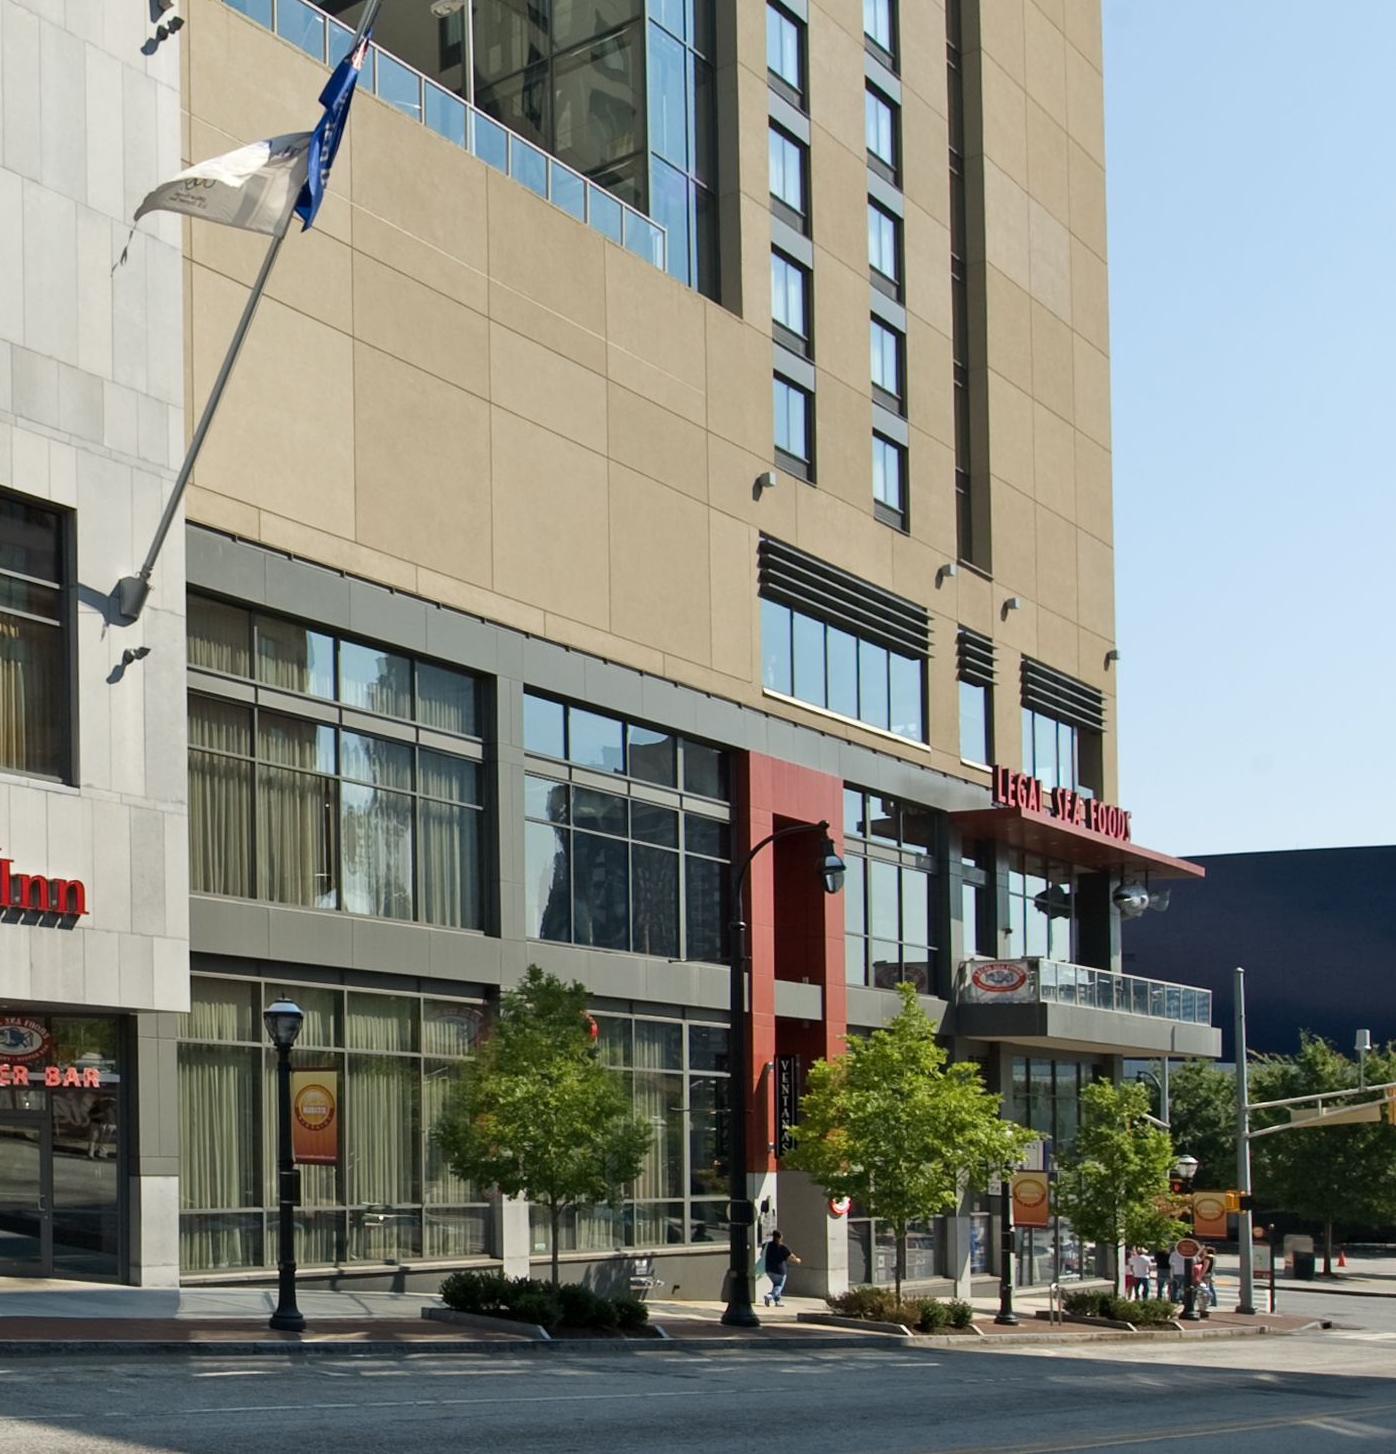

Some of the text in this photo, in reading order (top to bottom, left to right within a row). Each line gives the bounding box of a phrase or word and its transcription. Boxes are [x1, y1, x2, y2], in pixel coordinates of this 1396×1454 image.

[996, 764, 1132, 844] LEGAL SEA FOODS
[43, 1065, 101, 1089] BAR
[780, 1059, 791, 1152] VENTANAS
